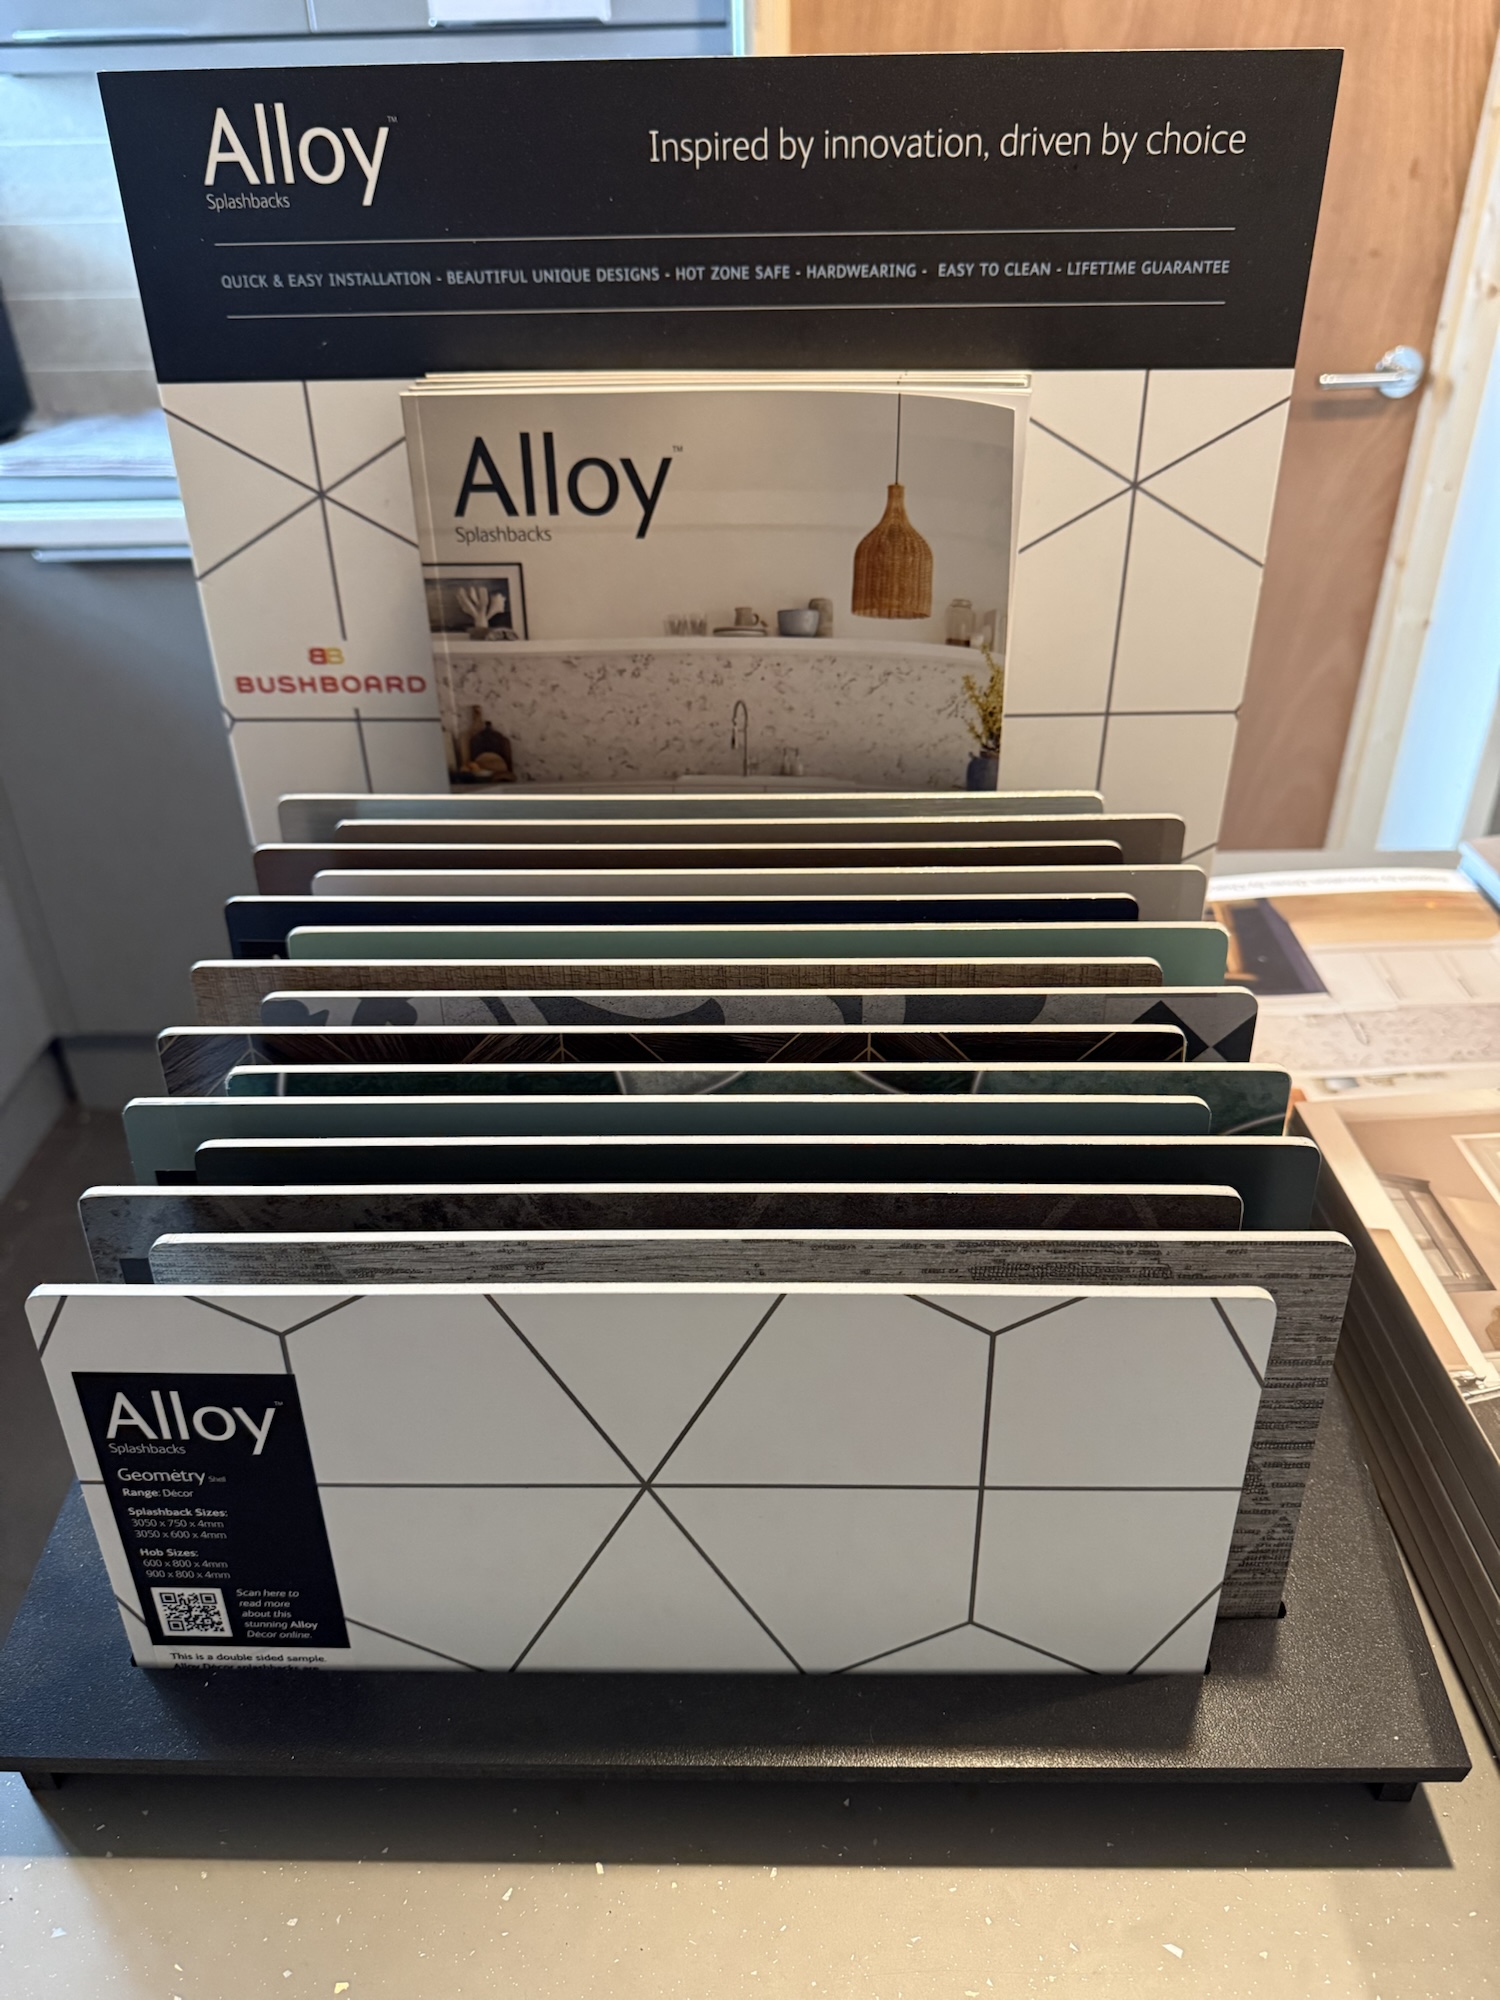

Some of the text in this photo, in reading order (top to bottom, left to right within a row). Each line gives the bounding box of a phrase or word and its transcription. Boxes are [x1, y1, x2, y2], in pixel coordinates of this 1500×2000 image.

[649, 121, 1247, 170] Inspired by innovation, driven by choice
[206, 192, 290, 212] Splashbacks
[221, 274, 268, 289] QUICK
[273, 274, 284, 288] &
[288, 273, 323, 288] EASY
[329, 271, 431, 287] INSTALLATION
[447, 270, 528, 285] BEAUTIFUL
[532, 268, 591, 285] UNIQUE
[596, 267, 660, 283] DESIGNS
[675, 266, 705, 281] HOT
[711, 266, 750, 281] ZONE
[755, 265, 790, 280] SAFE
[806, 263, 917, 279] HARDWEARING
[938, 262, 974, 278] EASY
[979, 262, 1000, 277] TO
[1004, 261, 1051, 277] CLEAN
[1067, 260, 1136, 276] LIFETIME
[1141, 260, 1230, 275] GUARANTEE
[455, 525, 553, 546] Splashbacks
[235, 675, 427, 694] BUSHBOARD
[108, 1442, 187, 1455] Splashbacks
[117, 1467, 206, 1486] Geometry
[122, 1487, 194, 1498] Range: Décor
[128, 1506, 228, 1517] Splashback Sizes:
[132, 1518, 157, 1528] 3050
[168, 1518, 187, 1528] 750
[198, 1519, 224, 1528] 4mm
[135, 1529, 160, 1539] 3050
[171, 1530, 190, 1539] 600
[201, 1531, 227, 1539] 4mm
[140, 1548, 199, 1558] Hob Sizes:
[143, 1558, 162, 1568] 600
[172, 1559, 192, 1568] 800
[202, 1560, 228, 1568] 4mm
[146, 1569, 165, 1579] 900
[175, 1570, 194, 1579] 800
[205, 1571, 231, 1579] 4mm
[236, 1588, 299, 1598] Scan here to
[239, 1599, 261, 1608] read
[242, 1610, 292, 1618] about this
[244, 1621, 318, 1630] stunning Alloy
[279, 1630, 312, 1639] online.
[170, 1652, 193, 1660] This
[216, 1653, 253, 1661] double
[256, 1653, 284, 1661] sided
[287, 1654, 327, 1663] sample.
